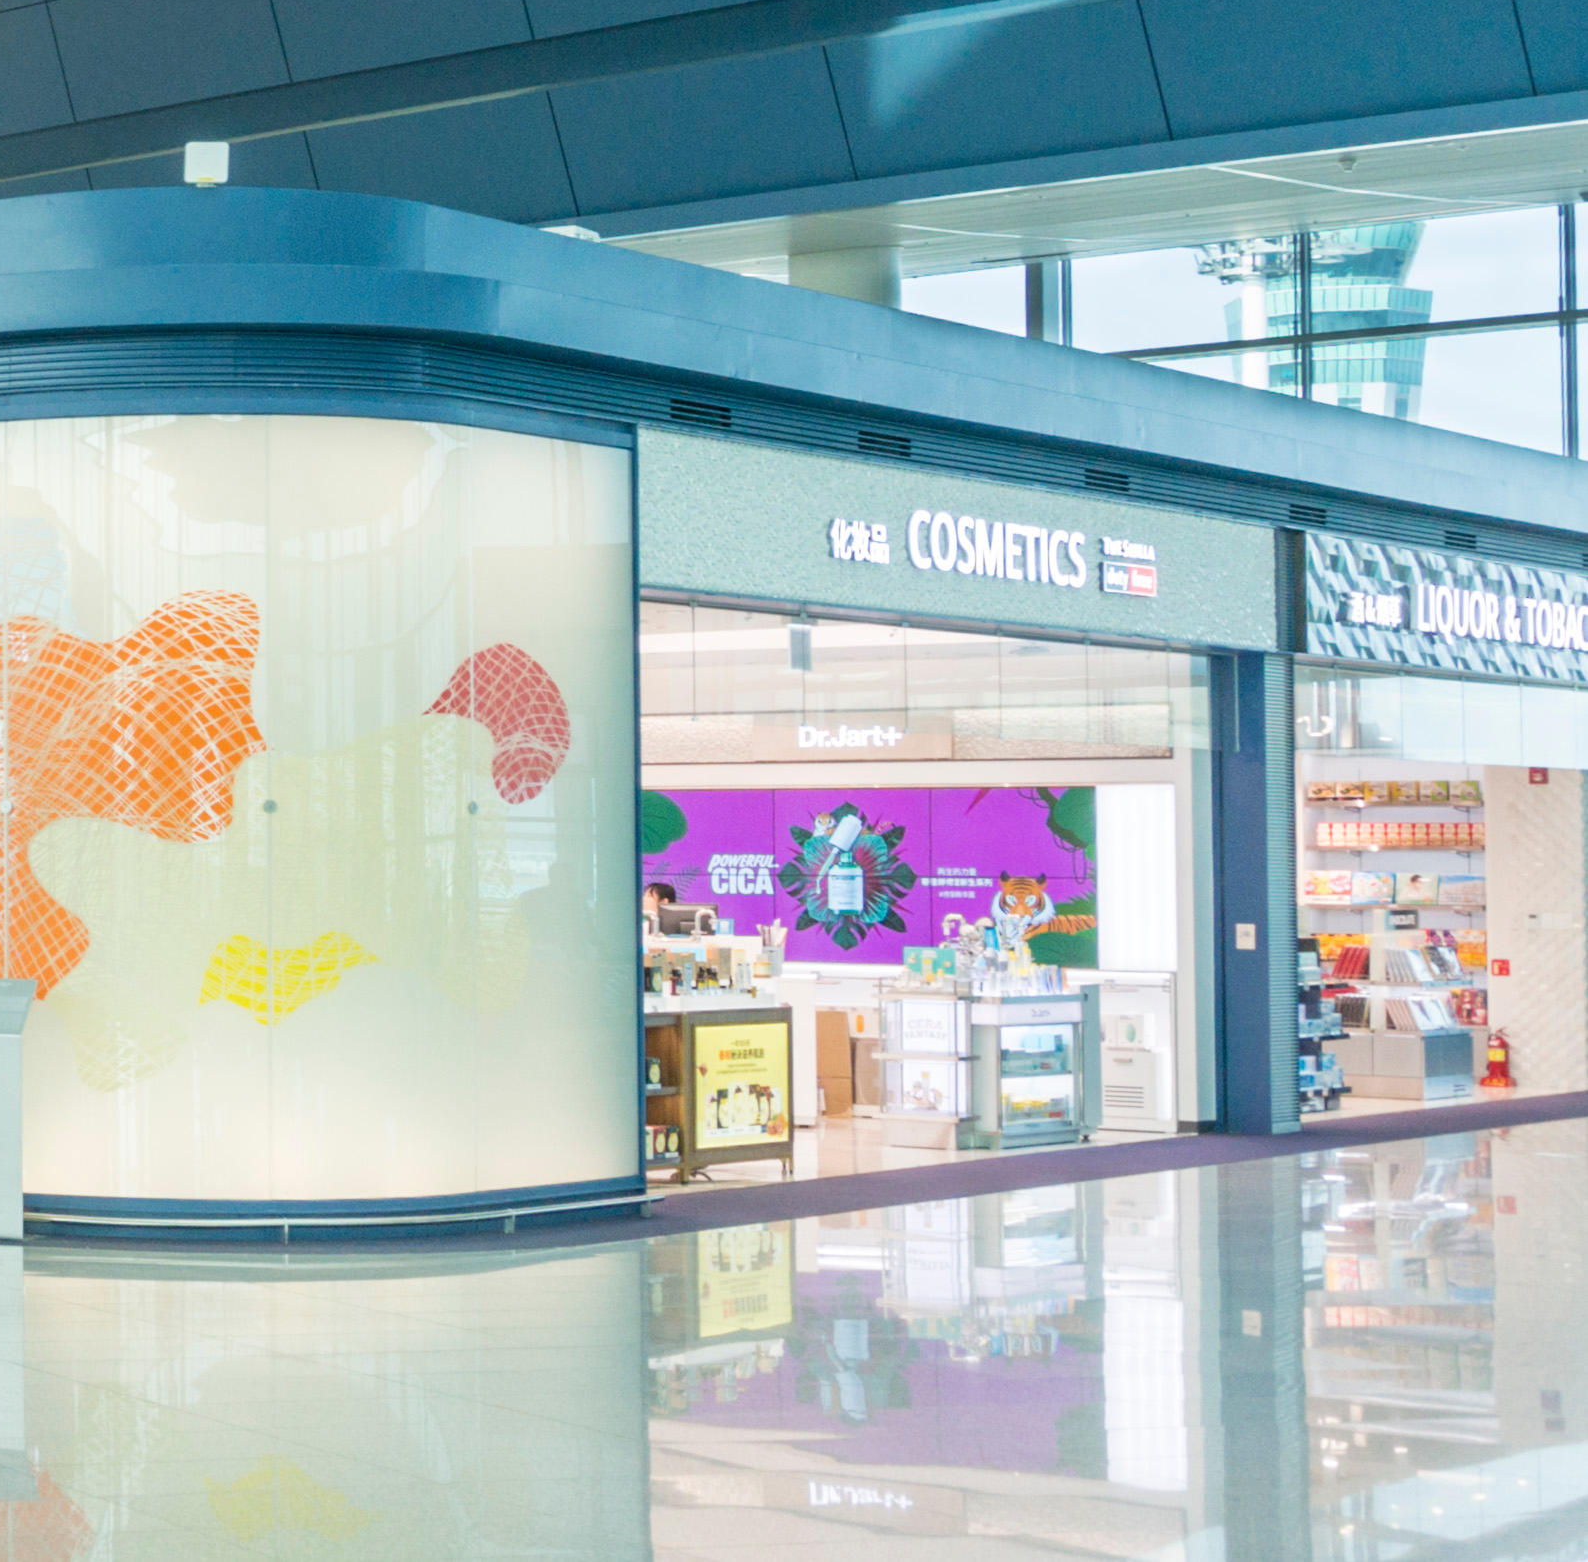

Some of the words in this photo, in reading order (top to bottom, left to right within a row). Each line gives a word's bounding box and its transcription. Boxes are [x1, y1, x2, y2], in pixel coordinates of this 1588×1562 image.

[908, 509, 1088, 589] COSMETICS
[1417, 583, 1502, 645] LIQUOR
[1504, 595, 1522, 644] &
[797, 724, 903, 749] Dr.Jart+
[708, 854, 779, 872] POWERFUL
[711, 867, 775, 895] CICA
